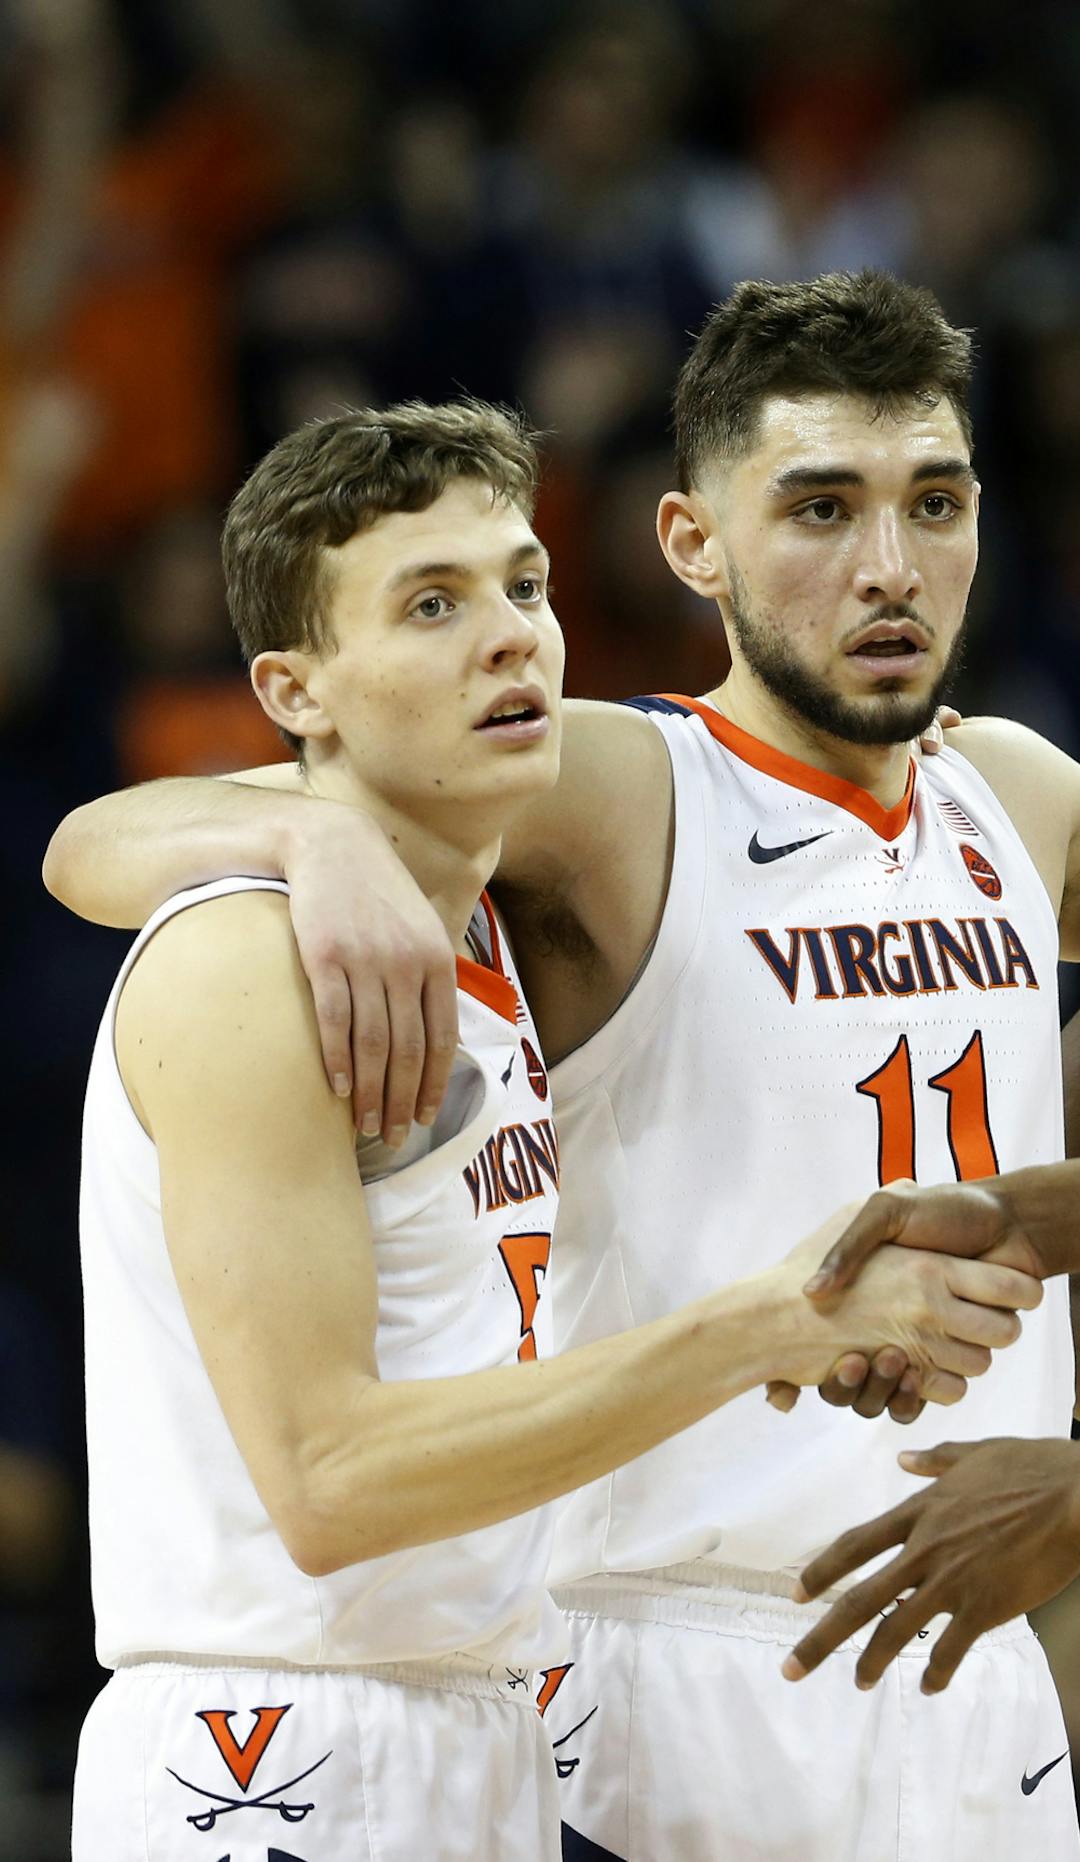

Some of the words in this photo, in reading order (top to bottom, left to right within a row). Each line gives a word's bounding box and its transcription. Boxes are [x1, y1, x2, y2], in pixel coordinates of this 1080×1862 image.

[743, 916, 1040, 1005] VIRGINIA
[855, 1029, 1000, 1187] 11
[195, 1703, 294, 1793] V
